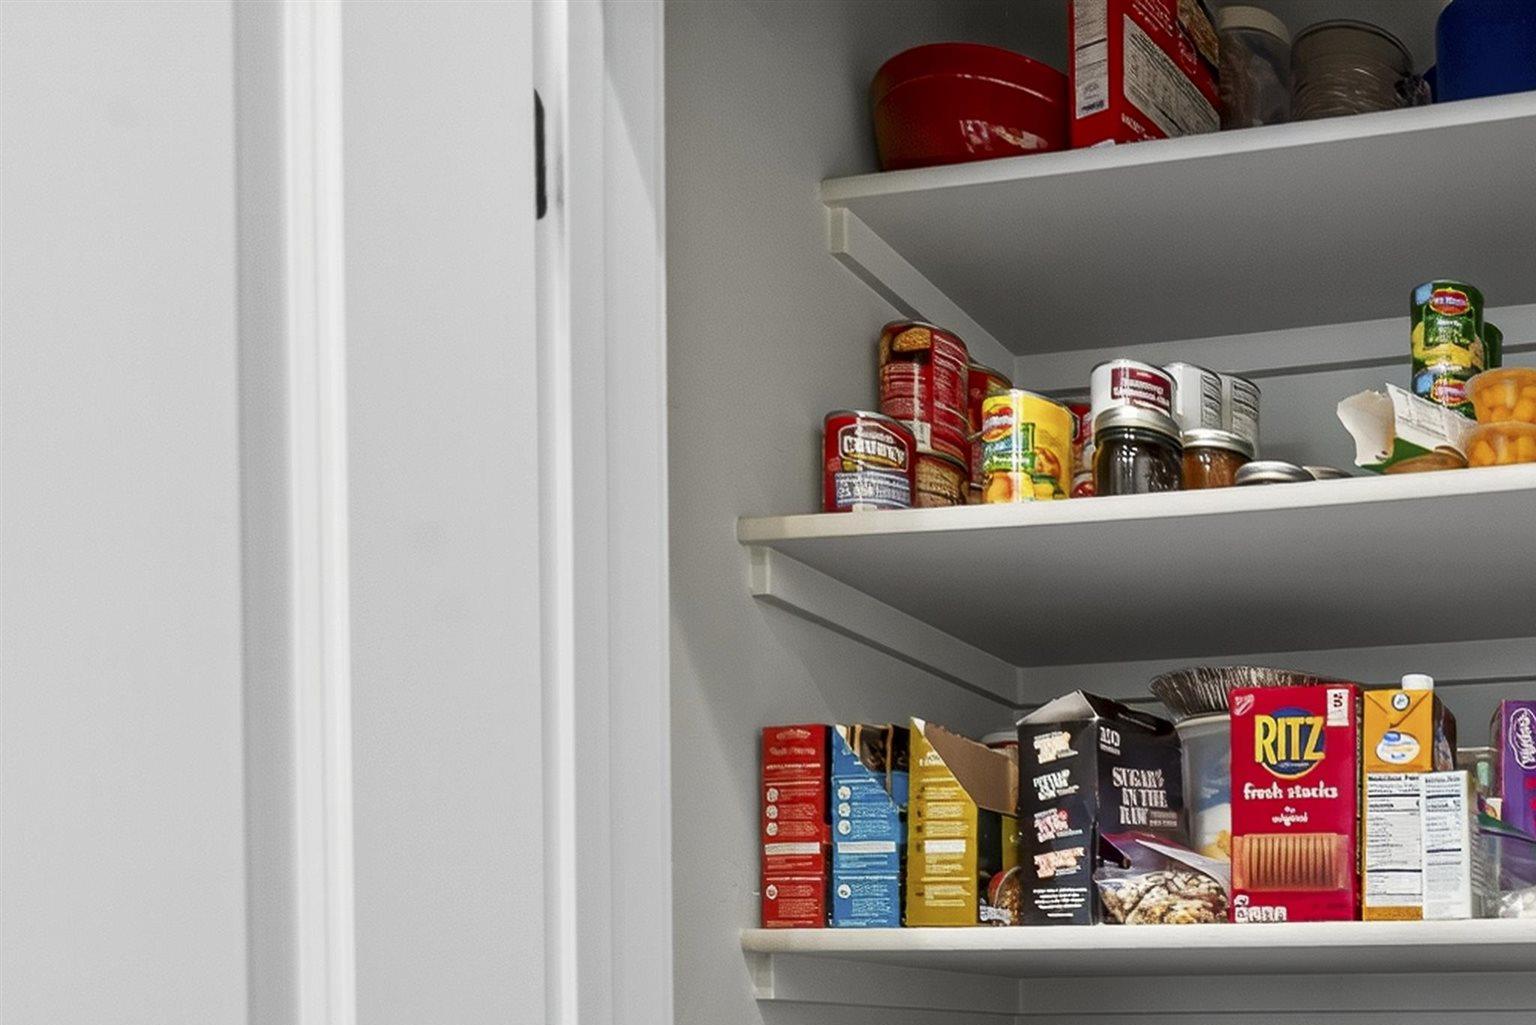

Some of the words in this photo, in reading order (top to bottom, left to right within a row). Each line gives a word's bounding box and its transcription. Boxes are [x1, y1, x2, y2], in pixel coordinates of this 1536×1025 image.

[1254, 714, 1326, 765] RITZ
[1112, 766, 1157, 789] SUGAR
[1121, 787, 1138, 806] IN
[1138, 789, 1169, 808] THE
[1119, 805, 1149, 825] RAW
